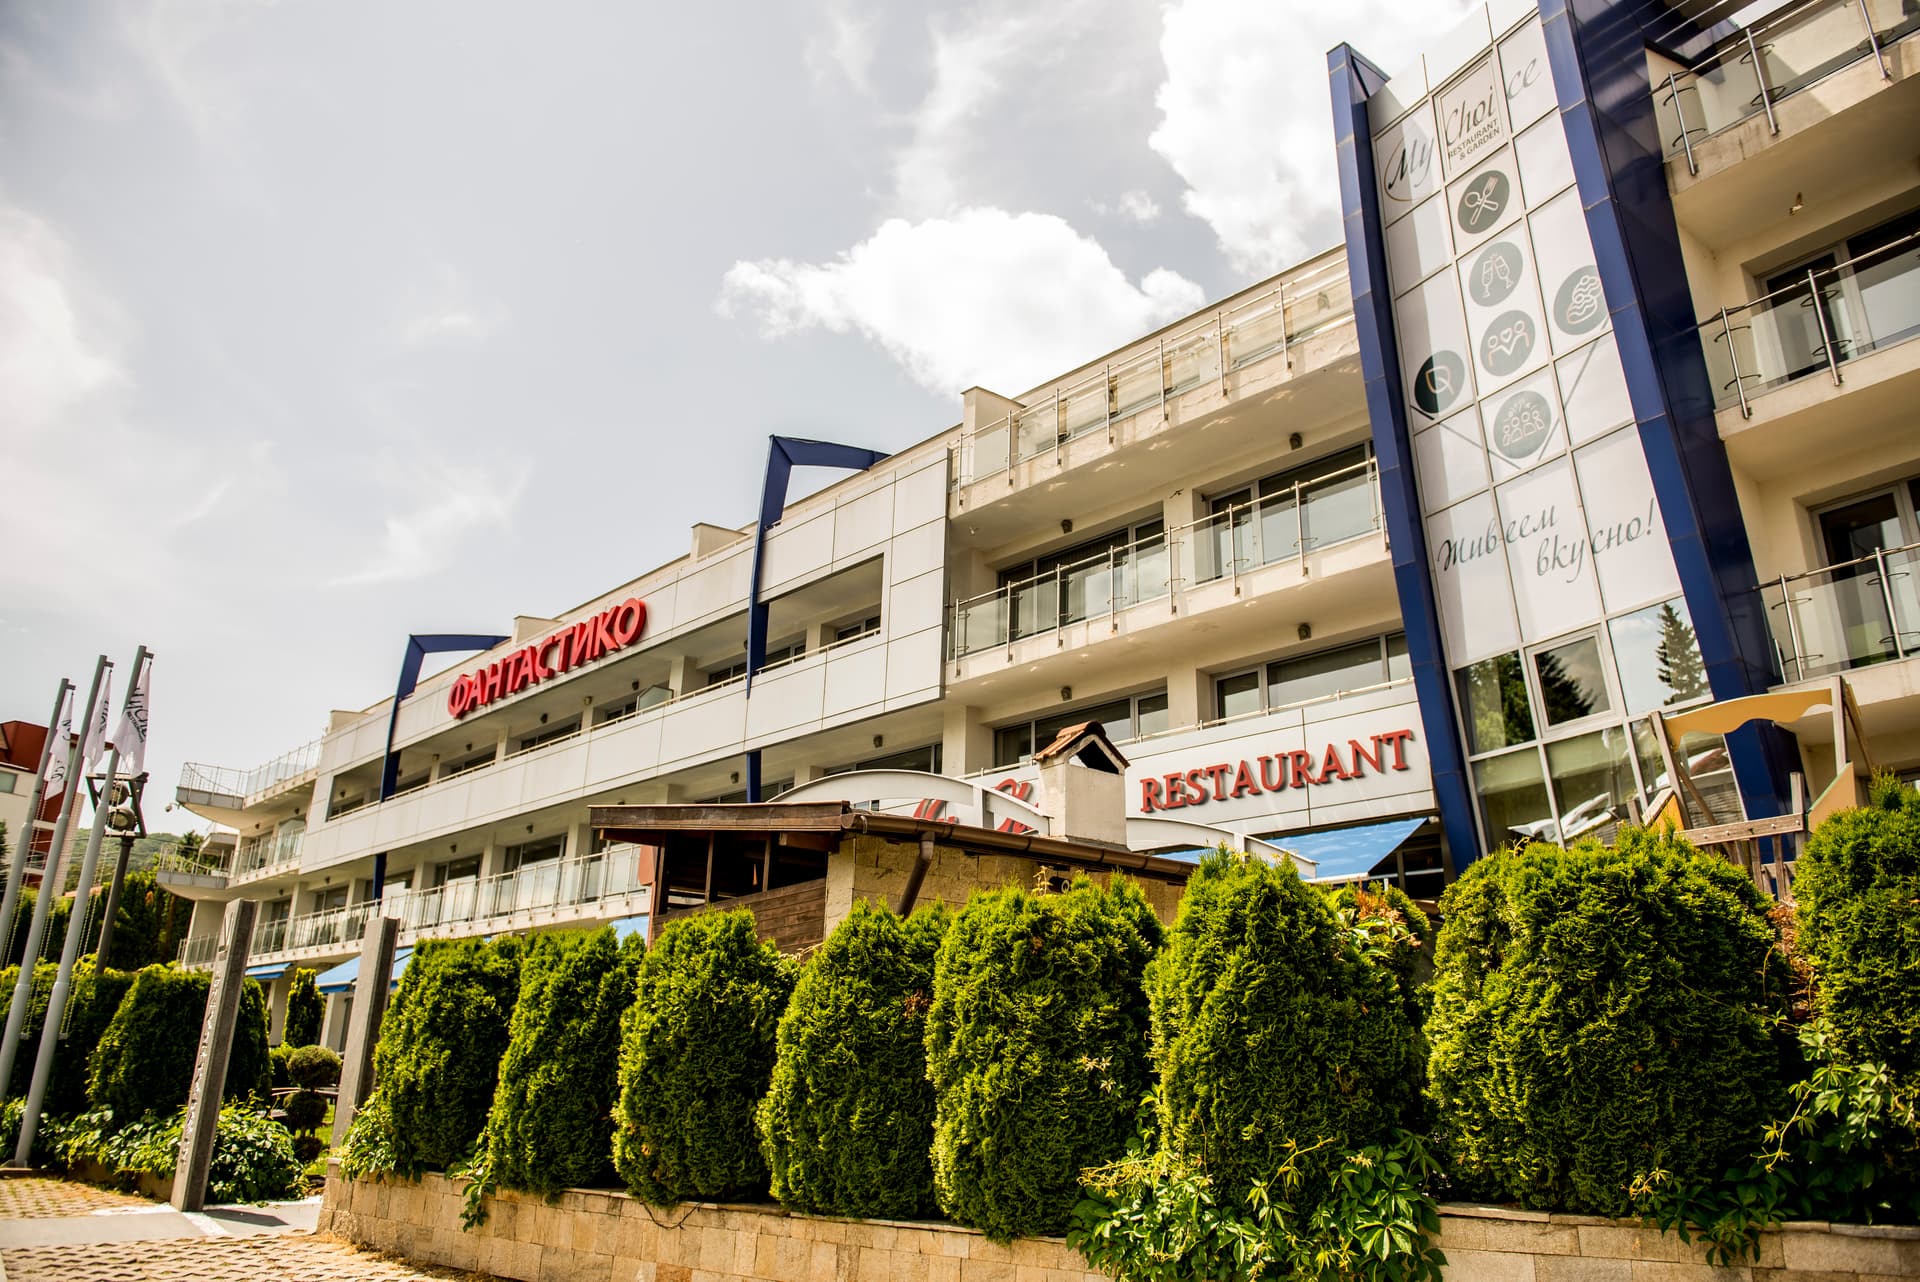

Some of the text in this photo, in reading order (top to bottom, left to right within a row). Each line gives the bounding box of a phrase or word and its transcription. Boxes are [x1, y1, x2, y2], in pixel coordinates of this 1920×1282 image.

[1448, 118, 1498, 158] RESTAURANT
[1459, 127, 1500, 161] & GARDEN
[1536, 497, 1655, 583] вкусно!
[448, 597, 647, 719] ФАНТАСТИКО
[1139, 729, 1413, 813] RESTAURANT
